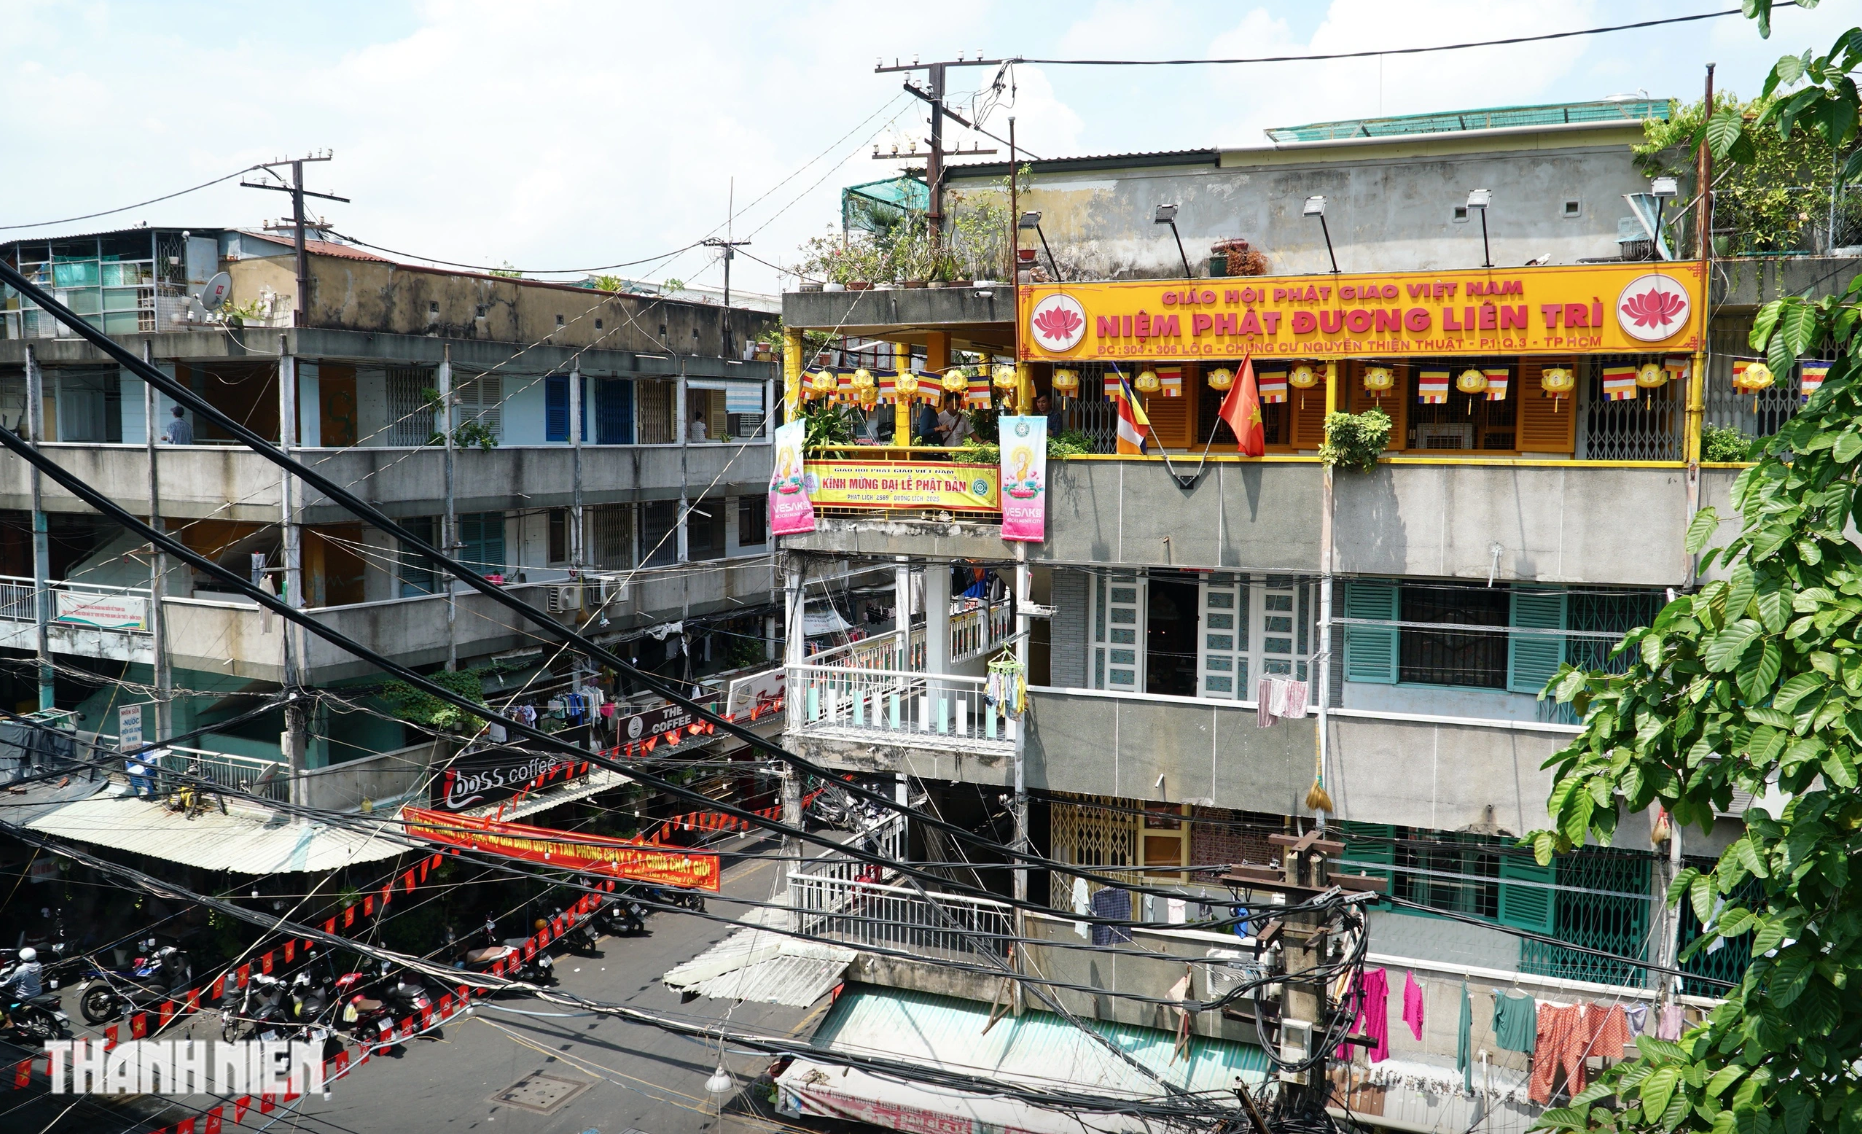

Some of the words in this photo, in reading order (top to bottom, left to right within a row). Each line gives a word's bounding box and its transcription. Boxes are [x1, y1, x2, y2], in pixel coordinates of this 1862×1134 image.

[1161, 287, 1217, 306] GIÁO
[1224, 286, 1266, 306] HỘI
[1273, 284, 1331, 304] PHẬT
[1339, 281, 1399, 301] GIÁO
[1406, 279, 1458, 301] VIỆT
[1466, 280, 1524, 297] NAM
[1096, 309, 1182, 343] NIỆM
[1191, 307, 1282, 341] PHẬT
[1443, 299, 1528, 332] LIÊN
[1541, 296, 1604, 329] TRÌ
[1156, 344, 1177, 354] 306
[1182, 341, 1200, 354] LÔ
[1203, 343, 1213, 354] G
[1225, 342, 1274, 354] CHUNG
[1278, 341, 1298, 353] CƯ
[1303, 337, 1362, 353] NGUYỄN
[1367, 337, 1415, 353] THIỆN
[1415, 337, 1464, 352] THUẬT
[822, 475, 846, 489] KÍNH
[849, 475, 879, 490] MỪNG
[881, 479, 899, 493] ĐẠI
[915, 477, 942, 494] PHẬT
[944, 475, 967, 492] ĐẢN
[773, 501, 803, 513] VESAK
[1004, 506, 1036, 518] VESAK
[662, 705, 683, 720] THE
[652, 713, 692, 734] COFFEE
[509, 757, 557, 783] coffee
[500, 835, 513, 847] GIA
[669, 855, 691, 874] CHÁY
[693, 857, 711, 877] GIỎI
